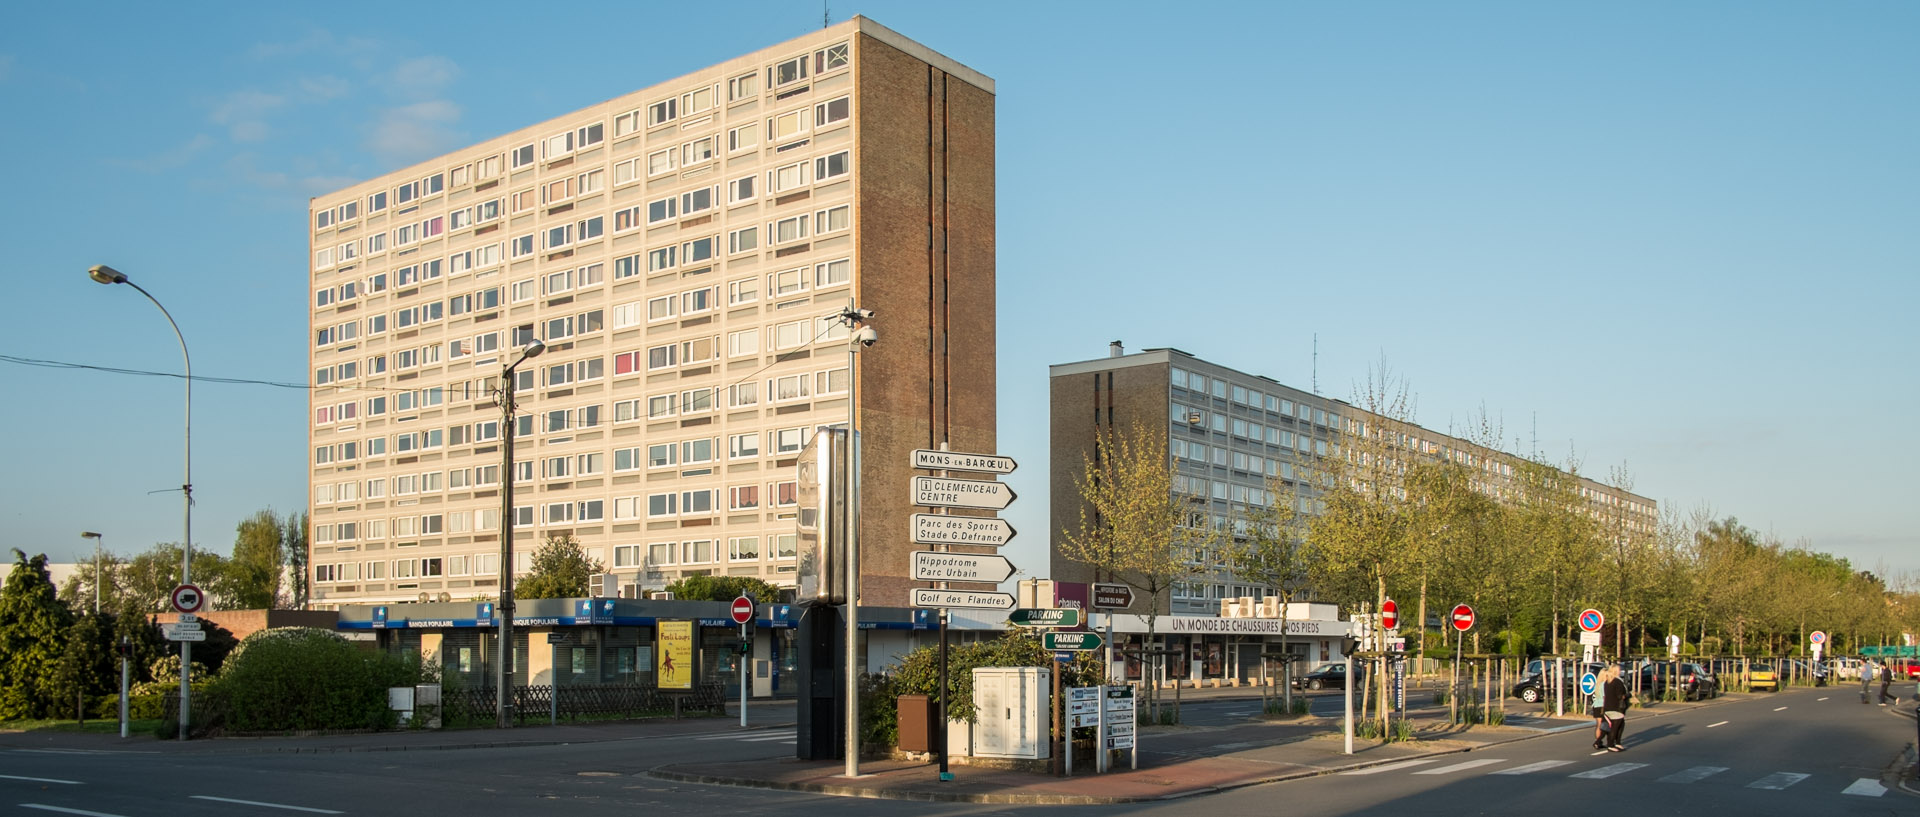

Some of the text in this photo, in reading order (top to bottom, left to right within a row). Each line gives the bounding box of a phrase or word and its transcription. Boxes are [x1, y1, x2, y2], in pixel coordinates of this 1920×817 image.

[934, 482, 998, 494] CLEMENCEAU
[920, 492, 958, 502] CENTRE
[920, 518, 998, 531] Parc des Sports
[920, 530, 947, 539] Stade
[920, 556, 977, 568] Hippodrome
[920, 568, 977, 578] Parc Urbain
[920, 594, 1006, 605] Golf des Flandres
[1027, 610, 1063, 619] PARKING
[1173, 619, 1185, 630] UN
[1188, 619, 1218, 631] MONDE
[1220, 620, 1229, 631] DE
[1232, 621, 1278, 632] CHAUSSURES
[1302, 622, 1319, 633] PIEDS
[675, 633, 690, 641] Loups
[1054, 634, 1084, 643] PARKING
